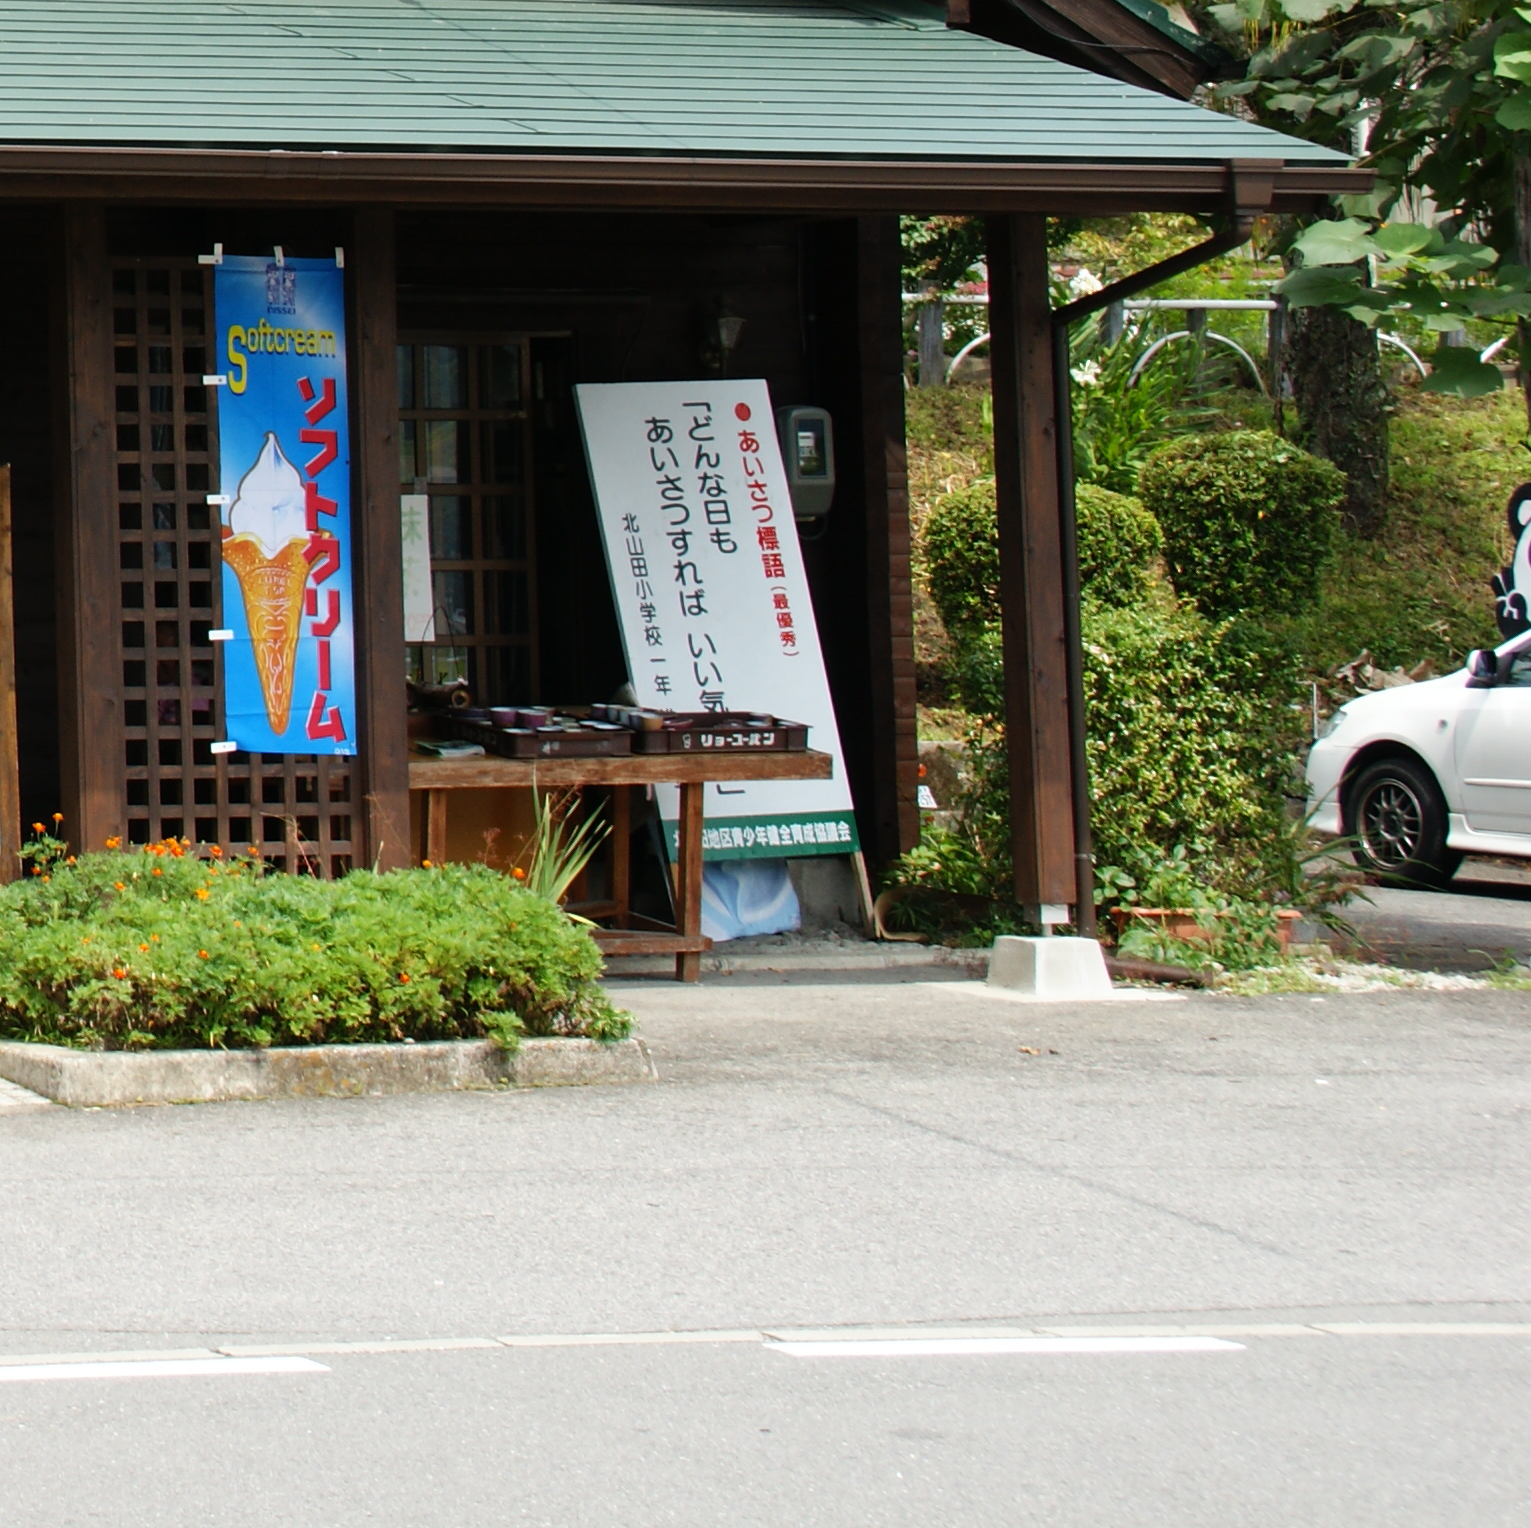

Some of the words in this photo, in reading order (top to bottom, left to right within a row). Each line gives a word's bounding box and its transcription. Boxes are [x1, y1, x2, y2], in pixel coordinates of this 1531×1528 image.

[227, 318, 336, 394] Softcream
[297, 376, 347, 744] ソフトクリーム
[645, 417, 708, 617] あいさつすれば
[682, 402, 738, 555] 「どんな日も
